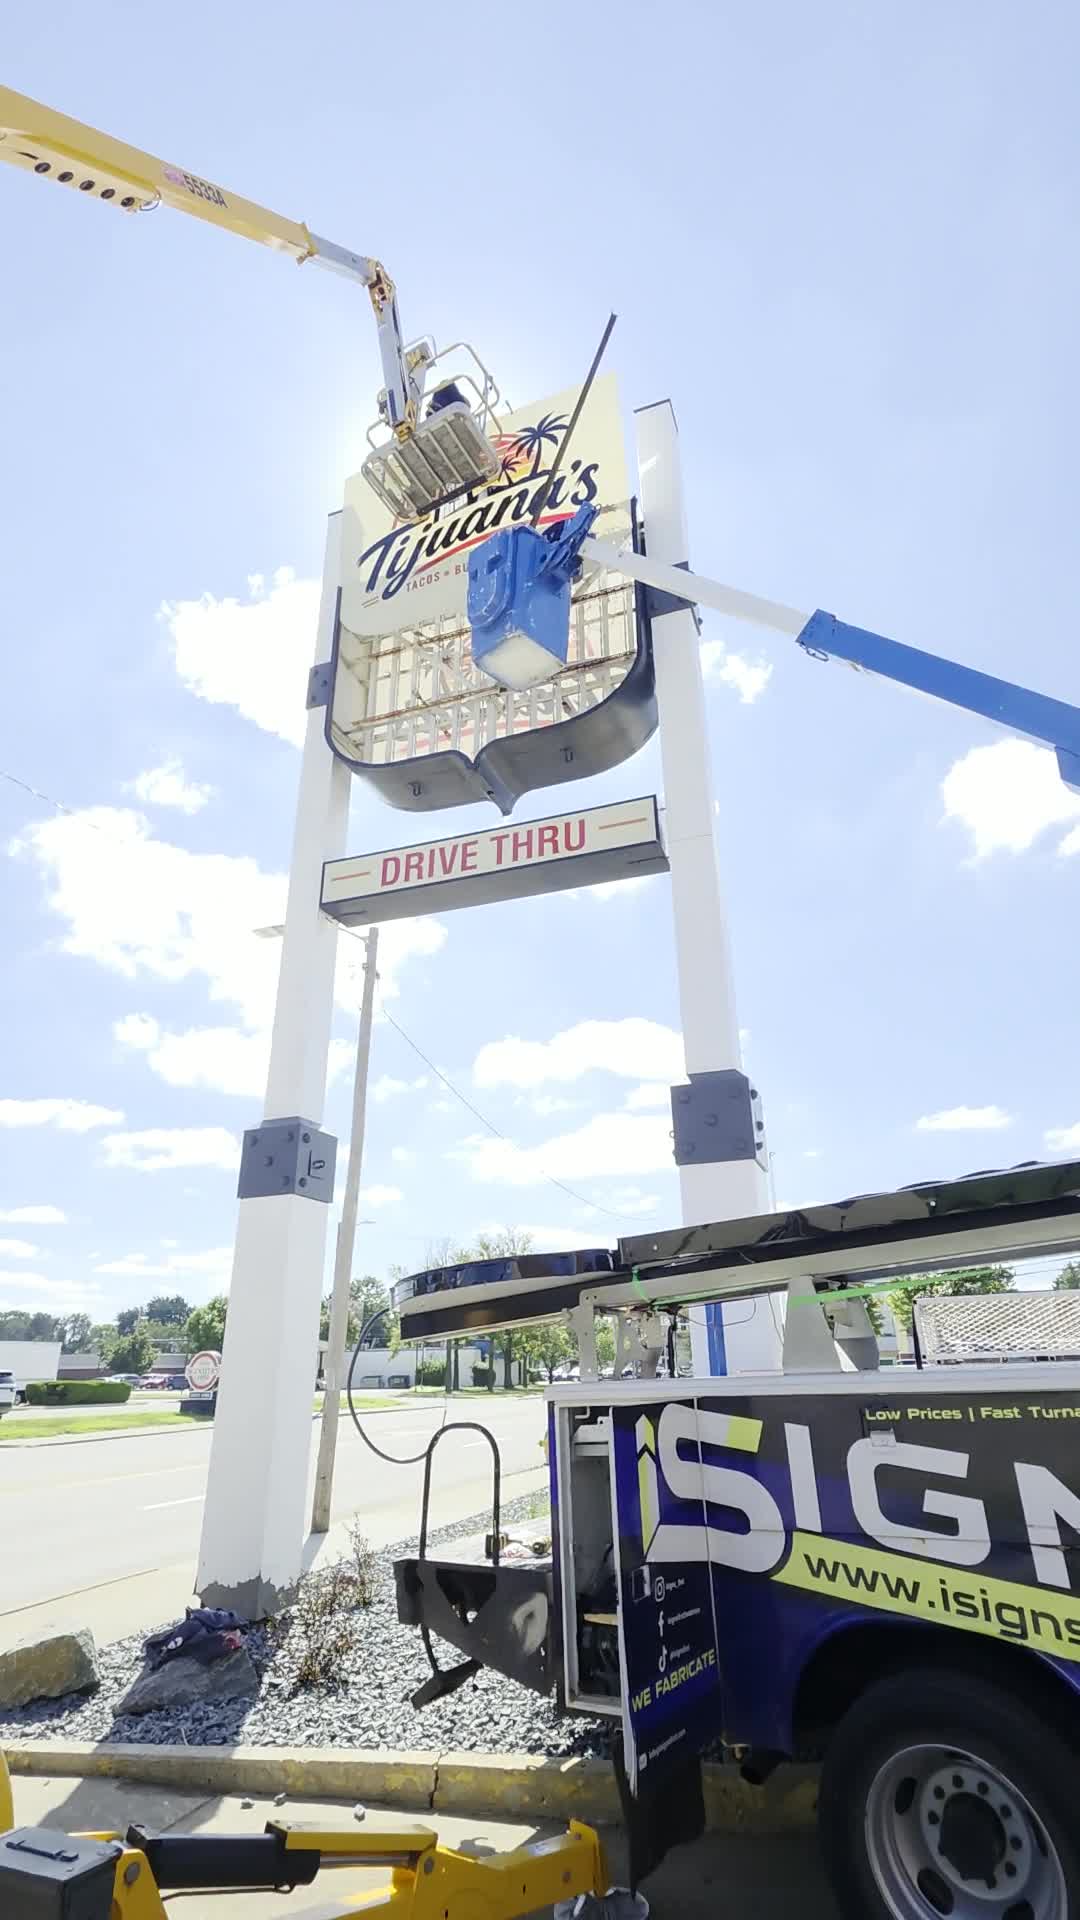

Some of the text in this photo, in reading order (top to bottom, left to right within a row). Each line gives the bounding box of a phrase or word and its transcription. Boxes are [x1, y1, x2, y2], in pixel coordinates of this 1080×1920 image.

[183, 173, 228, 208] 5533A
[358, 459, 599, 600] Tijuana's
[406, 571, 441, 592] TACOS
[381, 819, 586, 888] DRIVE THRU
[865, 1408, 900, 1421] Low
[907, 1408, 963, 1420] Prices
[980, 1407, 1022, 1419] Fast
[632, 1687, 652, 1713] WE
[655, 1649, 717, 1699] FABRICATE
